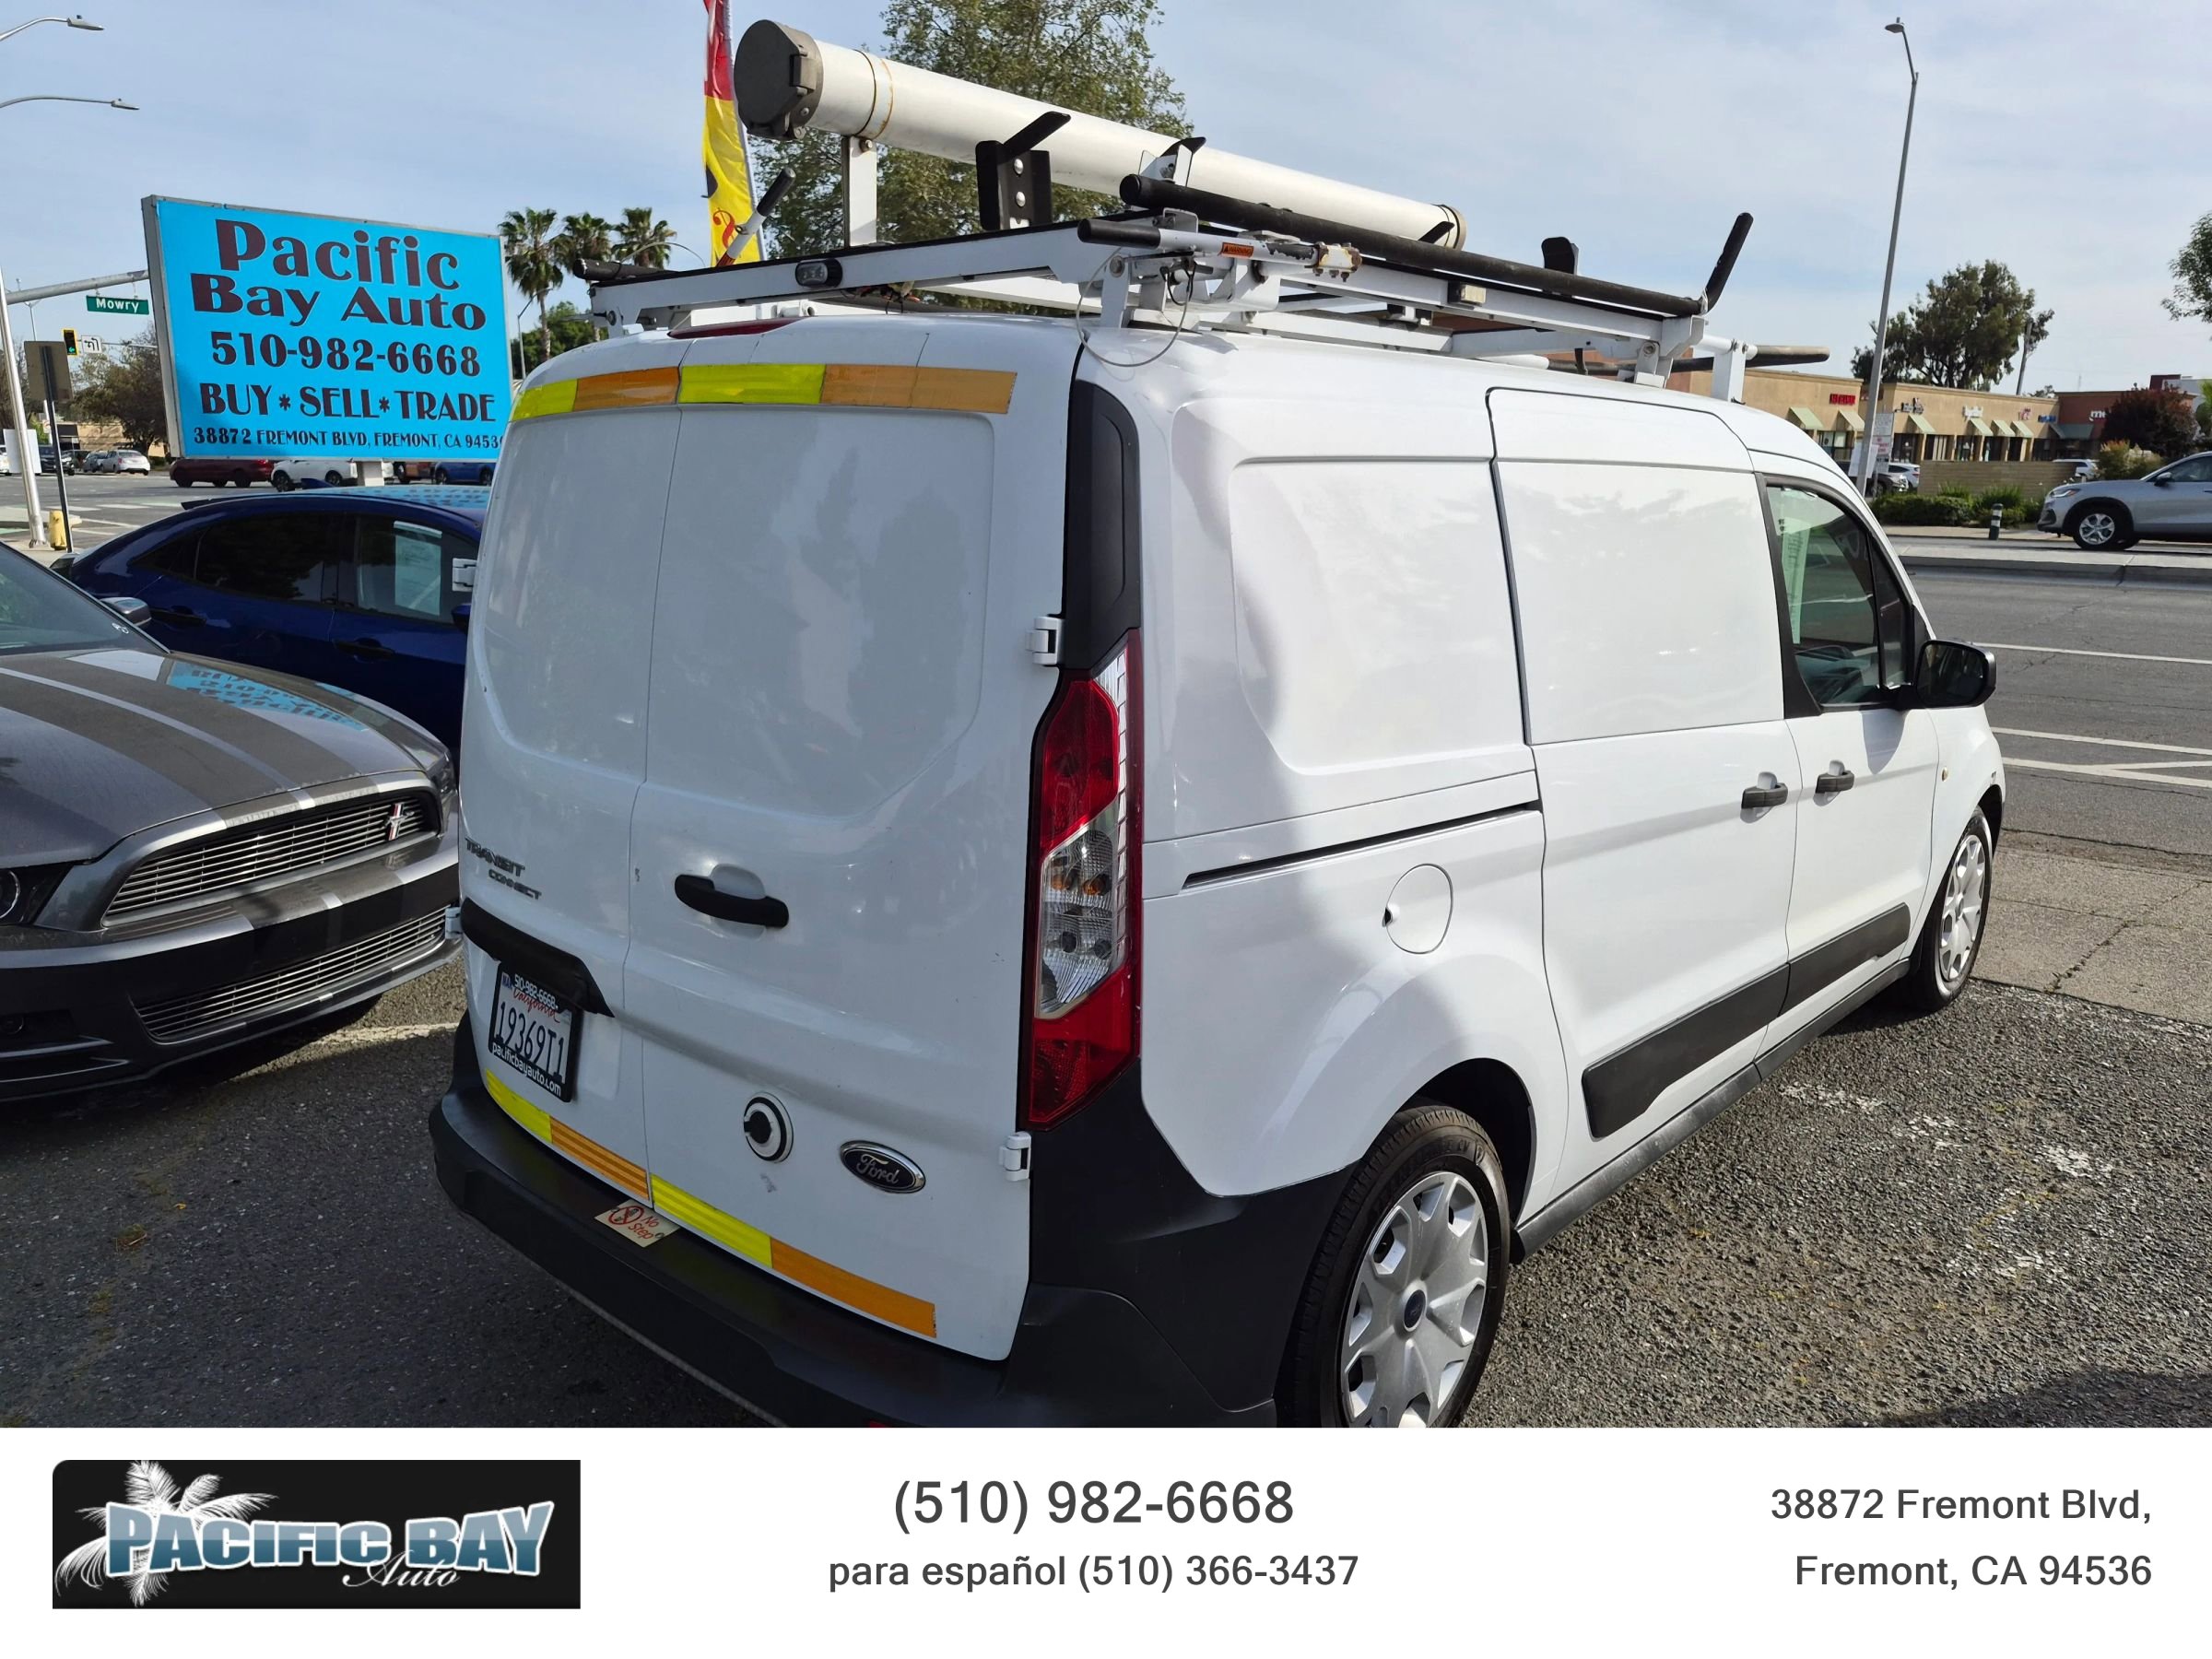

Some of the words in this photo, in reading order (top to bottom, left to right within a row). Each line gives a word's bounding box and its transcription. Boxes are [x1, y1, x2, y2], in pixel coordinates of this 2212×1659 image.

[215, 218, 460, 290] Pacific
[96, 298, 139, 313] Mowry
[190, 273, 320, 326] Bay
[340, 286, 487, 331] Auto
[210, 331, 480, 377] 510-982-6668
[199, 382, 272, 416] BUY
[300, 386, 379, 418] SELL
[394, 390, 496, 422] TRADE
[194, 427, 252, 444] 38872
[256, 429, 326, 446] FREMONT
[374, 432, 441, 450] FREMONT,
[444, 434, 462, 449] CA
[496, 1001, 565, 1077] 19369T1
[492, 1042, 561, 1097] pacificbayauto.com
[856, 1154, 900, 1183] Ford
[629, 1223, 653, 1239] Step
[641, 1216, 659, 1227] No
